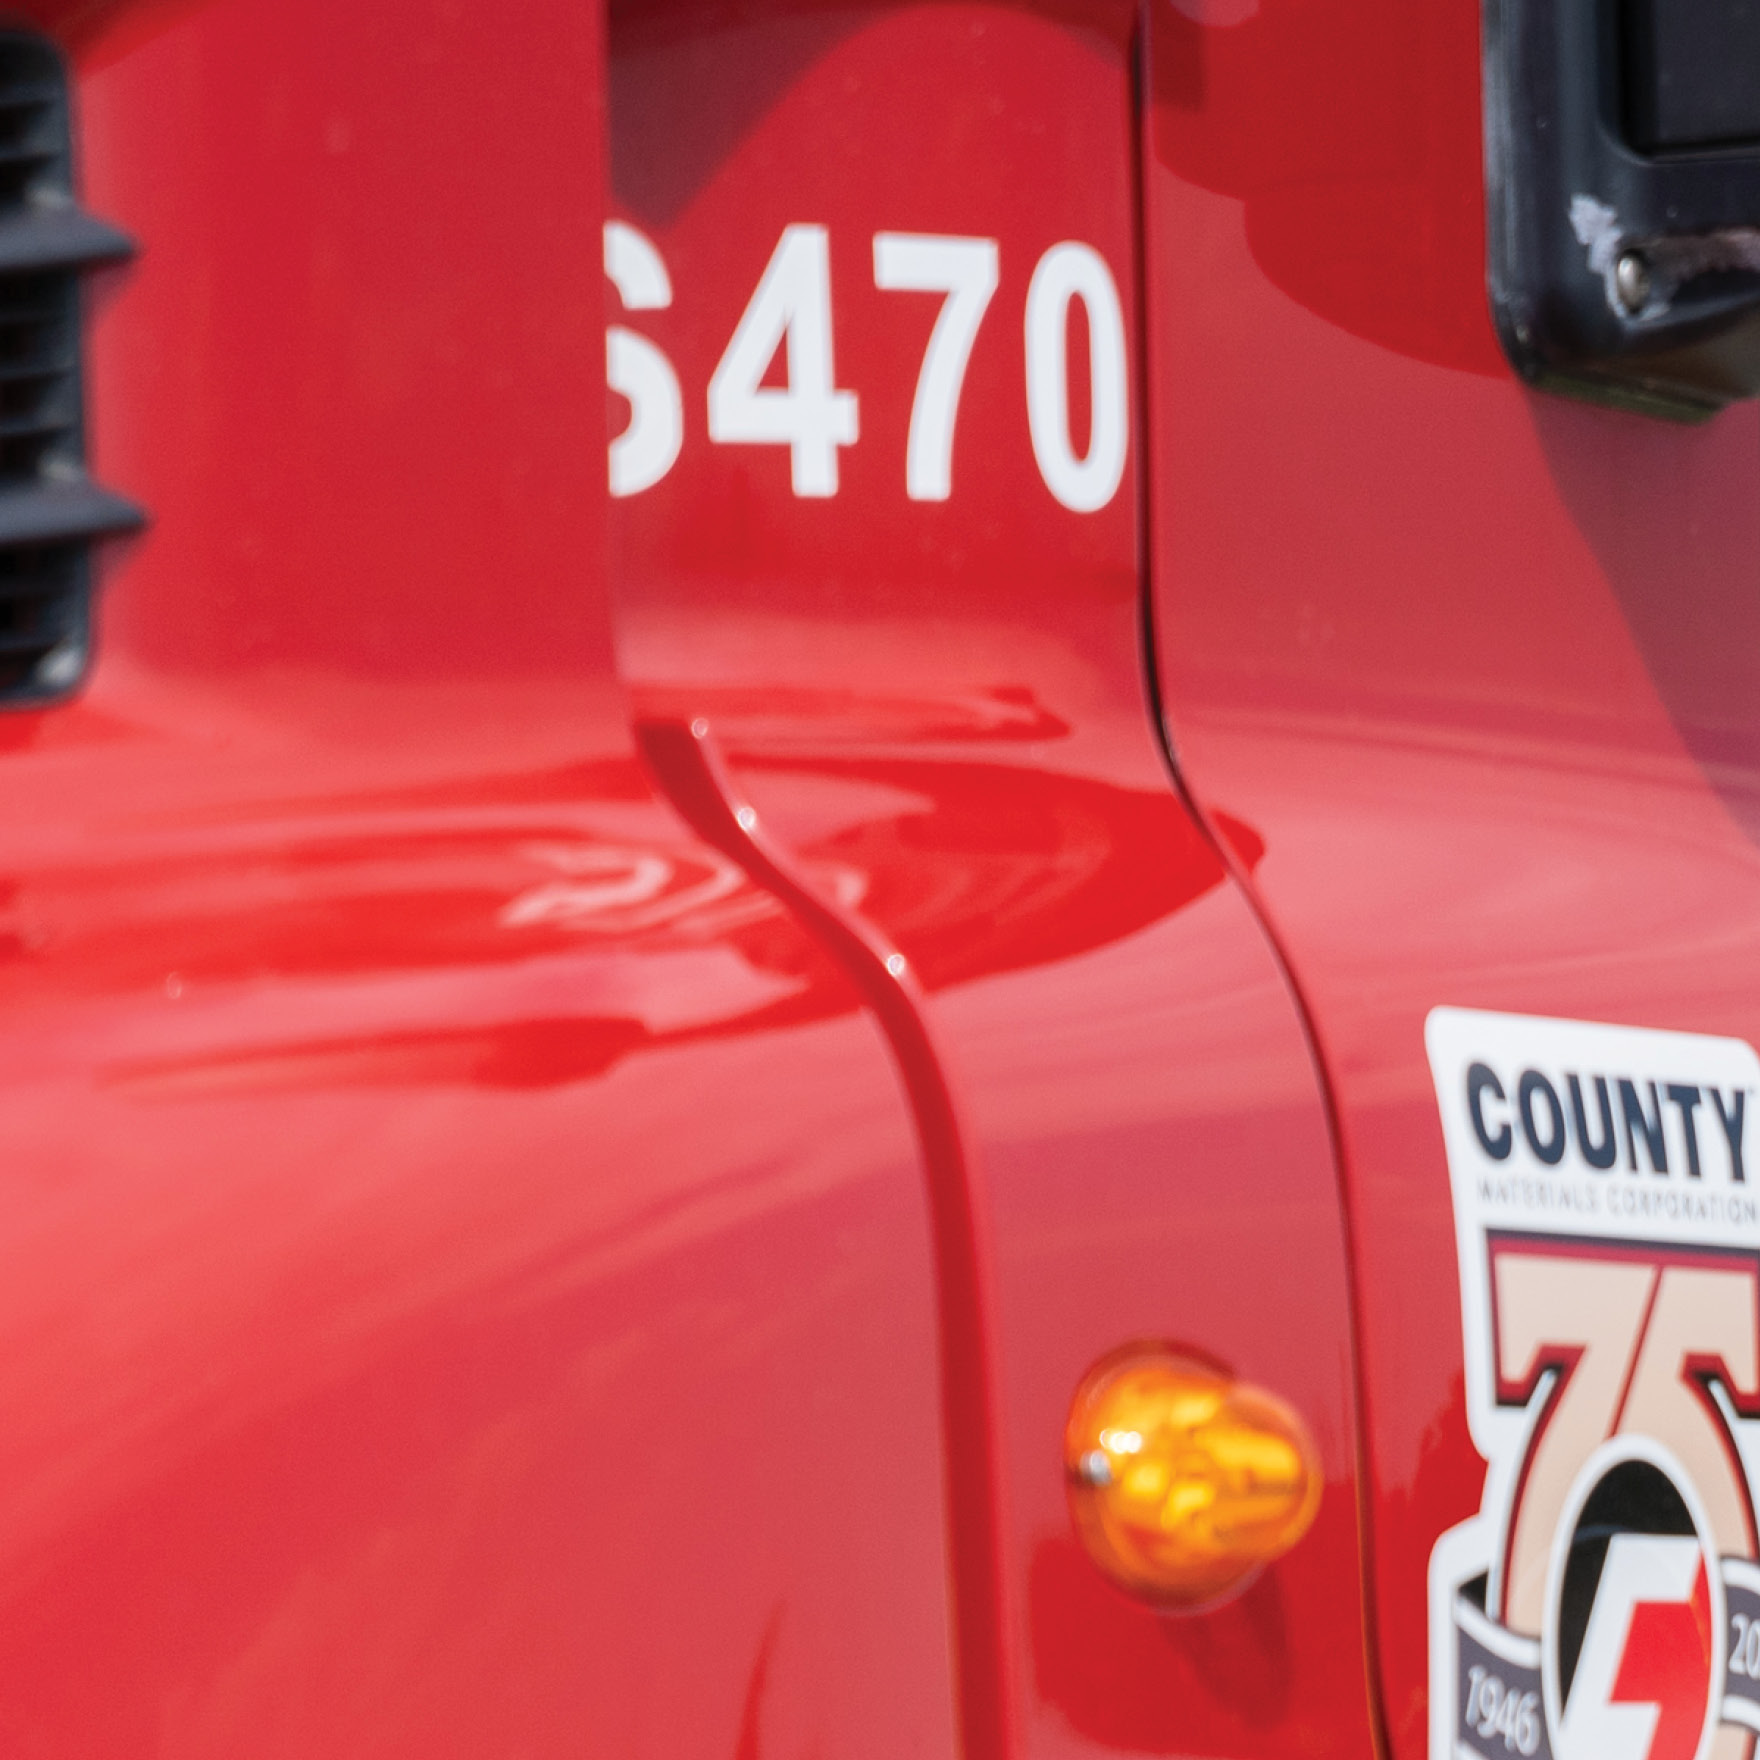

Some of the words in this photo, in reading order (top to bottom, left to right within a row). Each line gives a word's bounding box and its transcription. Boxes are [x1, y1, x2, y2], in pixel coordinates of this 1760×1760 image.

[1466, 1062, 1747, 1184] COUNTY
[1476, 1175, 1598, 1214] MATERIALS
[1607, 1183, 1758, 1226] CORPORATION
[1465, 1666, 1540, 1757] 1946
